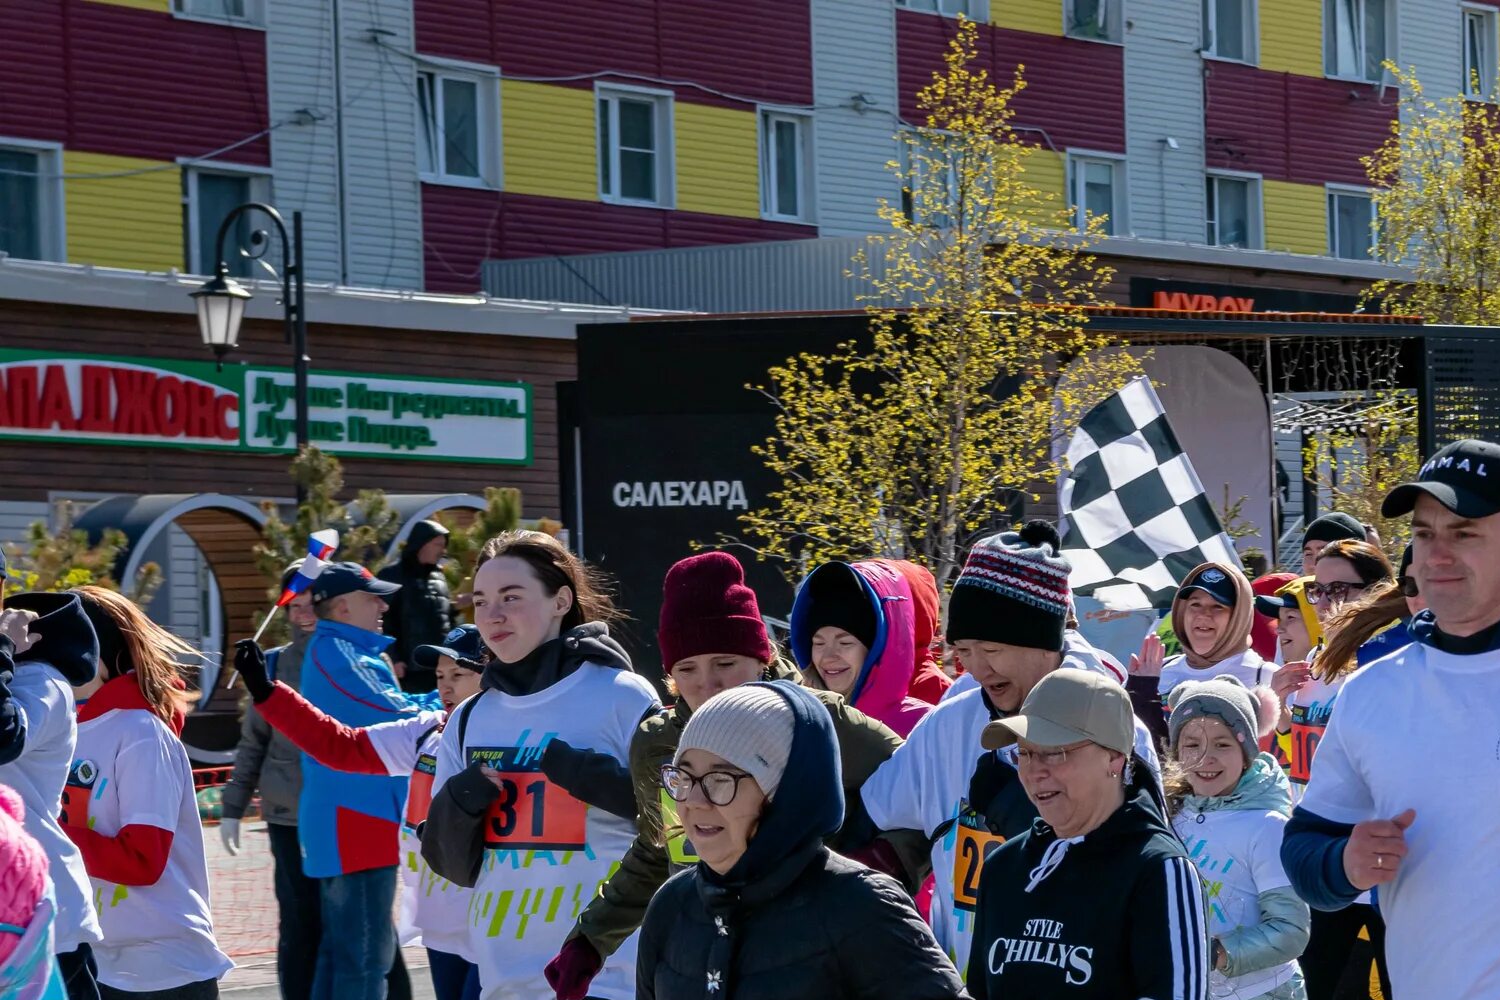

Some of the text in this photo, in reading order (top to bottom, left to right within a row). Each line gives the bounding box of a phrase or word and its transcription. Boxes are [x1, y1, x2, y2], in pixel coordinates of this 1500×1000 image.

[612, 480, 749, 510] САЛЕХАРД
[491, 780, 545, 837] 31
[1023, 919, 1064, 939] STYLE
[988, 937, 1093, 985] CHILLYS
